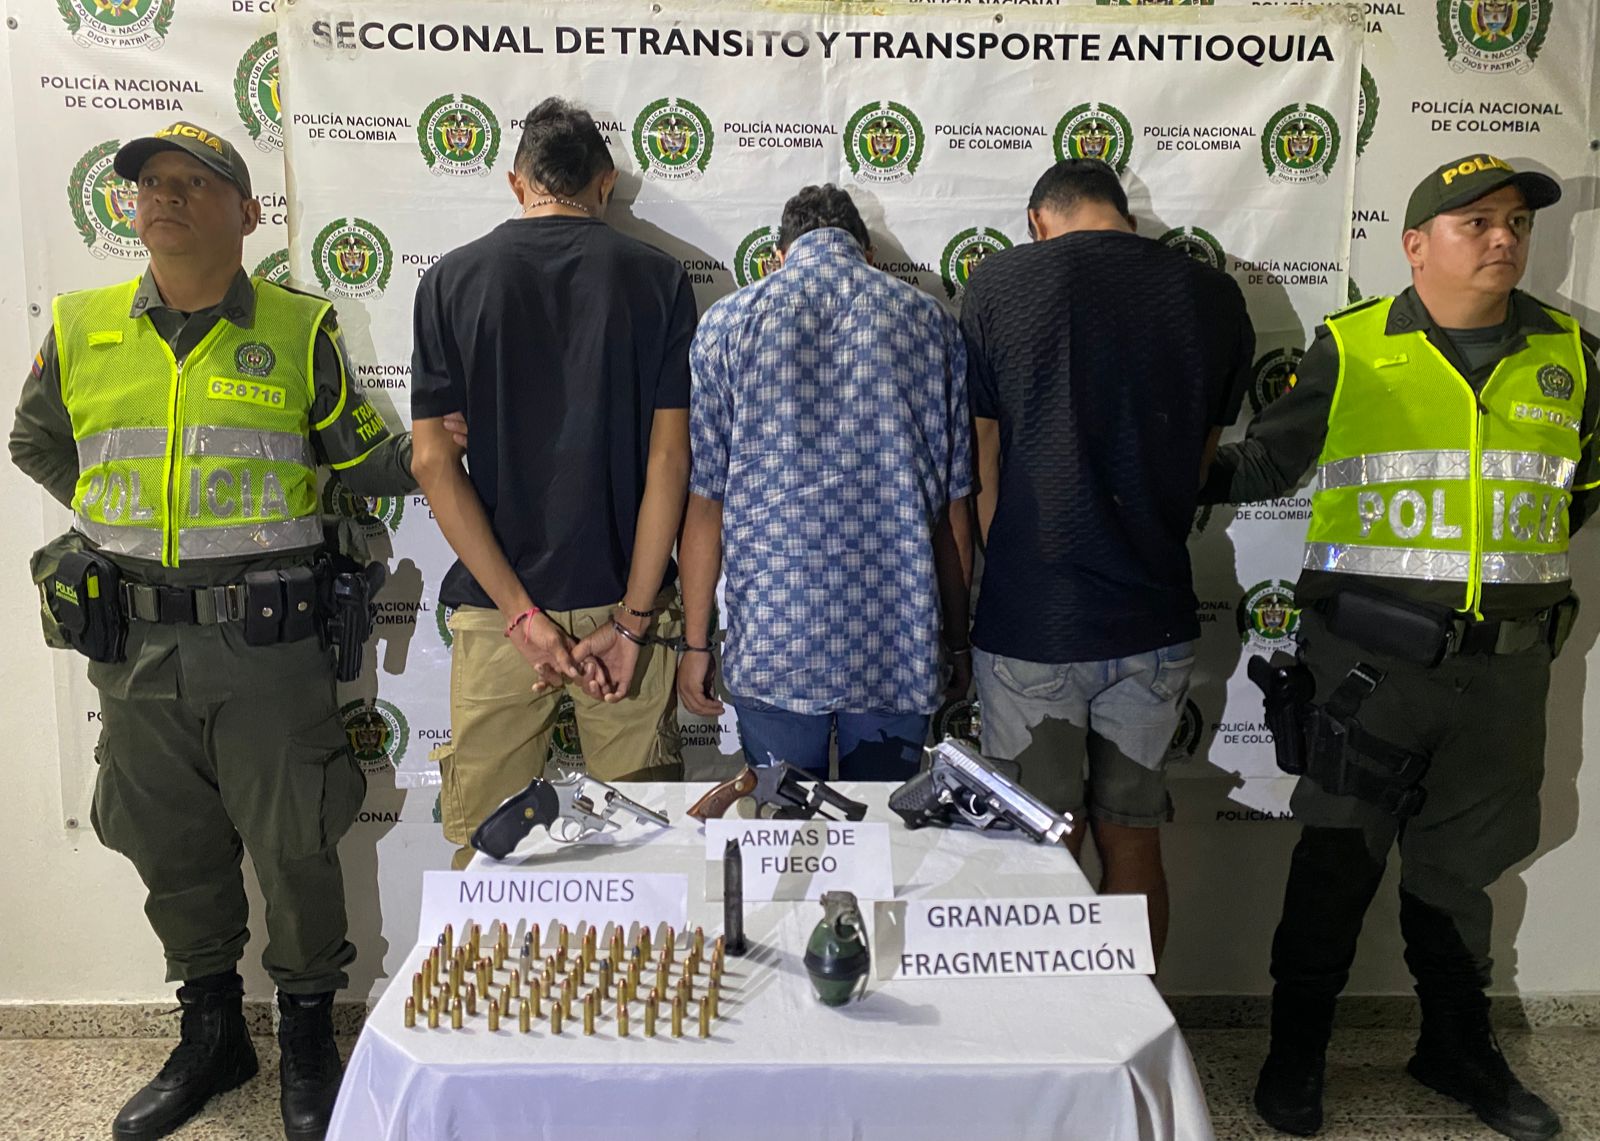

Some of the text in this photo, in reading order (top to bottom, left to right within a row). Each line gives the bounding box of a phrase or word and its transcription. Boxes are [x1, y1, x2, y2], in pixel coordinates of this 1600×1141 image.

[232, 1, 254, 12] DE
[119, 5, 159, 35] NACIONAL
[119, 33, 151, 46] PATRIA
[312, 20, 1334, 67] SECCIONAL DE TRÁNSITO Y TRANSPORTE ANTIOQUIA
[1491, 32, 1533, 59] NACIONAL
[1490, 57, 1521, 70] PATRIA
[41, 75, 204, 93] POLICÍA NACIONAL
[65, 95, 184, 111] DE COLOMBIA
[1412, 99, 1563, 115] POLICÍA NACIONAL
[293, 112, 412, 128] POLICÍA NACIONAL
[470, 108, 490, 141] COLOMBIA
[1431, 119, 1540, 132] DE COLOMBIA
[684, 111, 704, 145] COLOMBIA
[724, 120, 838, 135] POLICÍA NACIONAL
[896, 114, 915, 147] COLOMBIA
[935, 122, 1048, 136] POLICÍA NACIONAL
[1106, 115, 1124, 148] COLOMBIA
[1143, 124, 1257, 137] POLICÍA NACIONAL
[1313, 116, 1331, 149] COLOMBIA
[308, 128, 397, 141] DE COLOMBIA
[267, 134, 284, 149] DIO
[739, 137, 823, 148] DE COLOMBIA
[949, 139, 1033, 150] DE COLOMBIA
[1157, 140, 1241, 150] DE COLOMBIA
[460, 146, 488, 166] NACIONAL
[133, 250, 150, 258] PAT
[362, 231, 383, 264] COLOMBIA
[402, 254, 440, 265] POLIC
[682, 260, 730, 271] CIONAL
[1234, 259, 1344, 272] POLICÍA NACIONAL
[1248, 275, 1328, 285] DE COLOMBIA
[358, 365, 412, 376] NACIONA
[360, 378, 406, 389] LOMBIA
[212, 381, 282, 405] 628716
[1271, 497, 1312, 508] NACION
[1236, 510, 1314, 520] DE COLOMBIA
[375, 602, 431, 612] ACIONAL
[375, 615, 416, 625] OMBIA
[418, 729, 452, 740] POLIC
[680, 724, 731, 734] ACIONAL
[680, 736, 717, 746] OMBIA
[1224, 734, 1274, 744] DE COLO
[741, 829, 855, 847] ARMAS DE
[761, 855, 837, 874] FUEGO
[459, 879, 635, 903] MUNICIONES
[927, 903, 1102, 928] GRANADA DE
[900, 942, 1136, 976] FRAGMENTACIÓN
